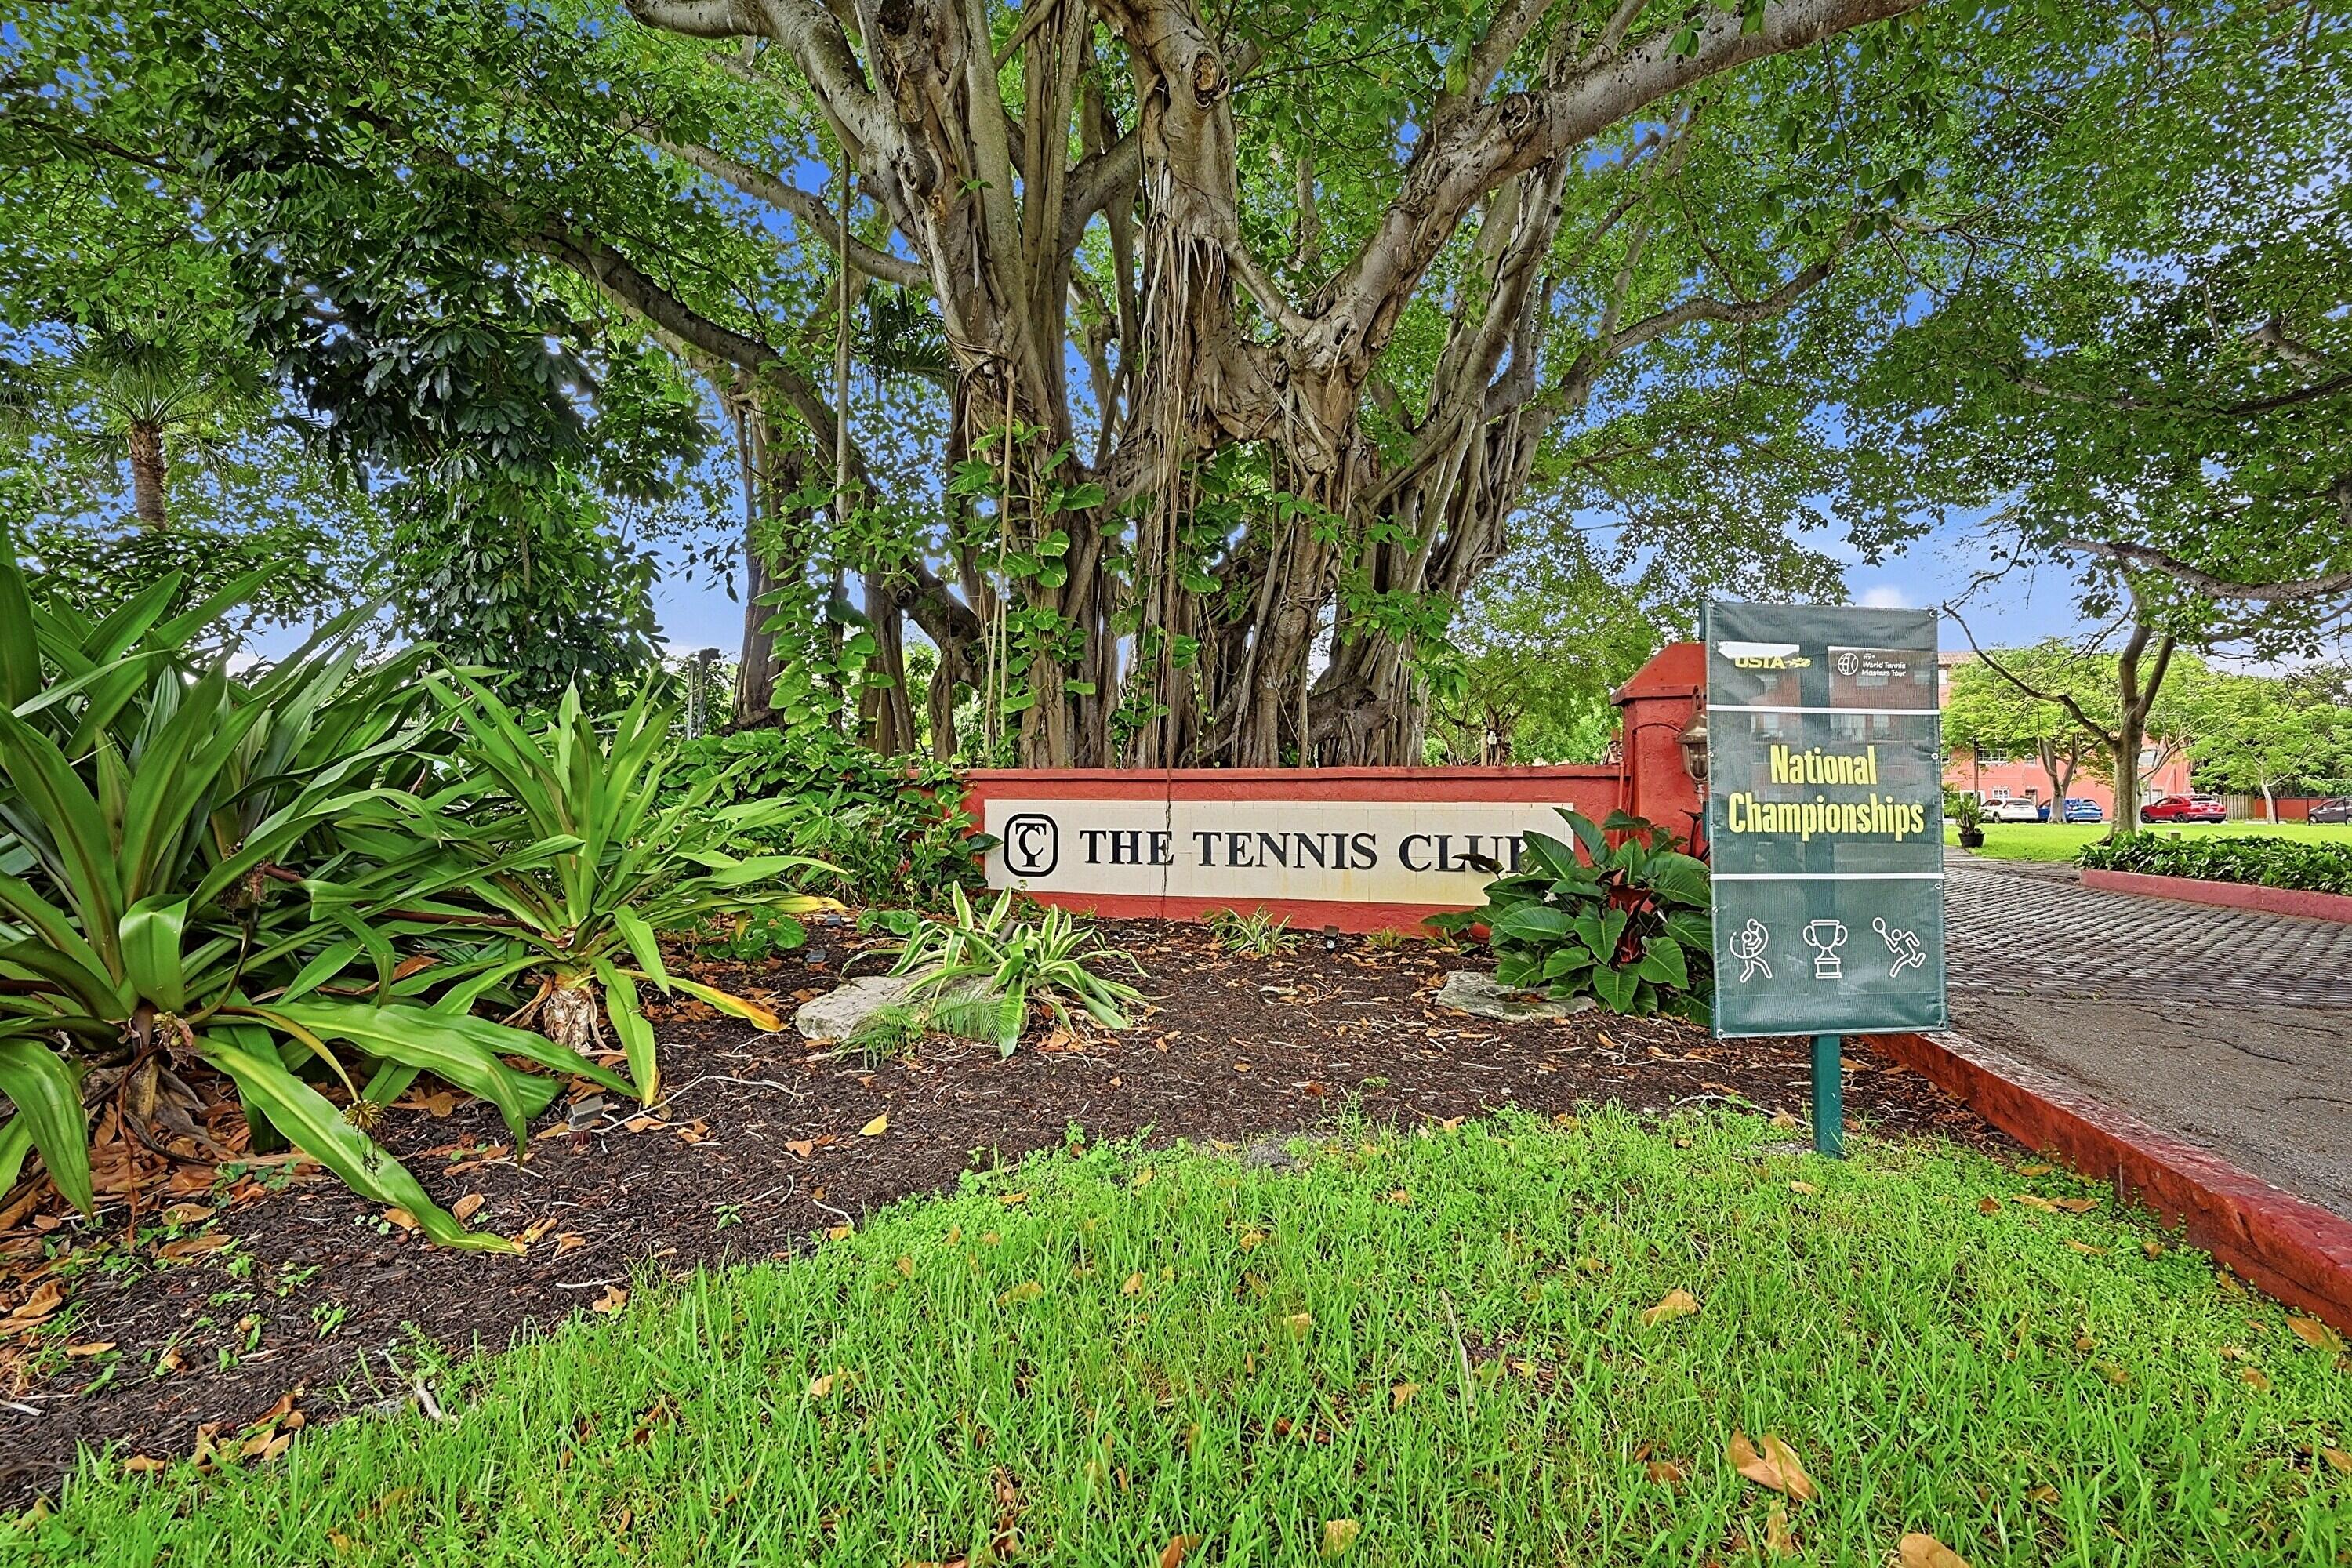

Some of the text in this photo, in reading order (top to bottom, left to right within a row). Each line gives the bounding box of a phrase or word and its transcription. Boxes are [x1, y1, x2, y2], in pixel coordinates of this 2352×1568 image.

[1770, 745, 1877, 785] National
[1728, 791, 1925, 842] Championships
[1079, 829, 1174, 866] THE
[1192, 831, 1377, 870] TENNIS
